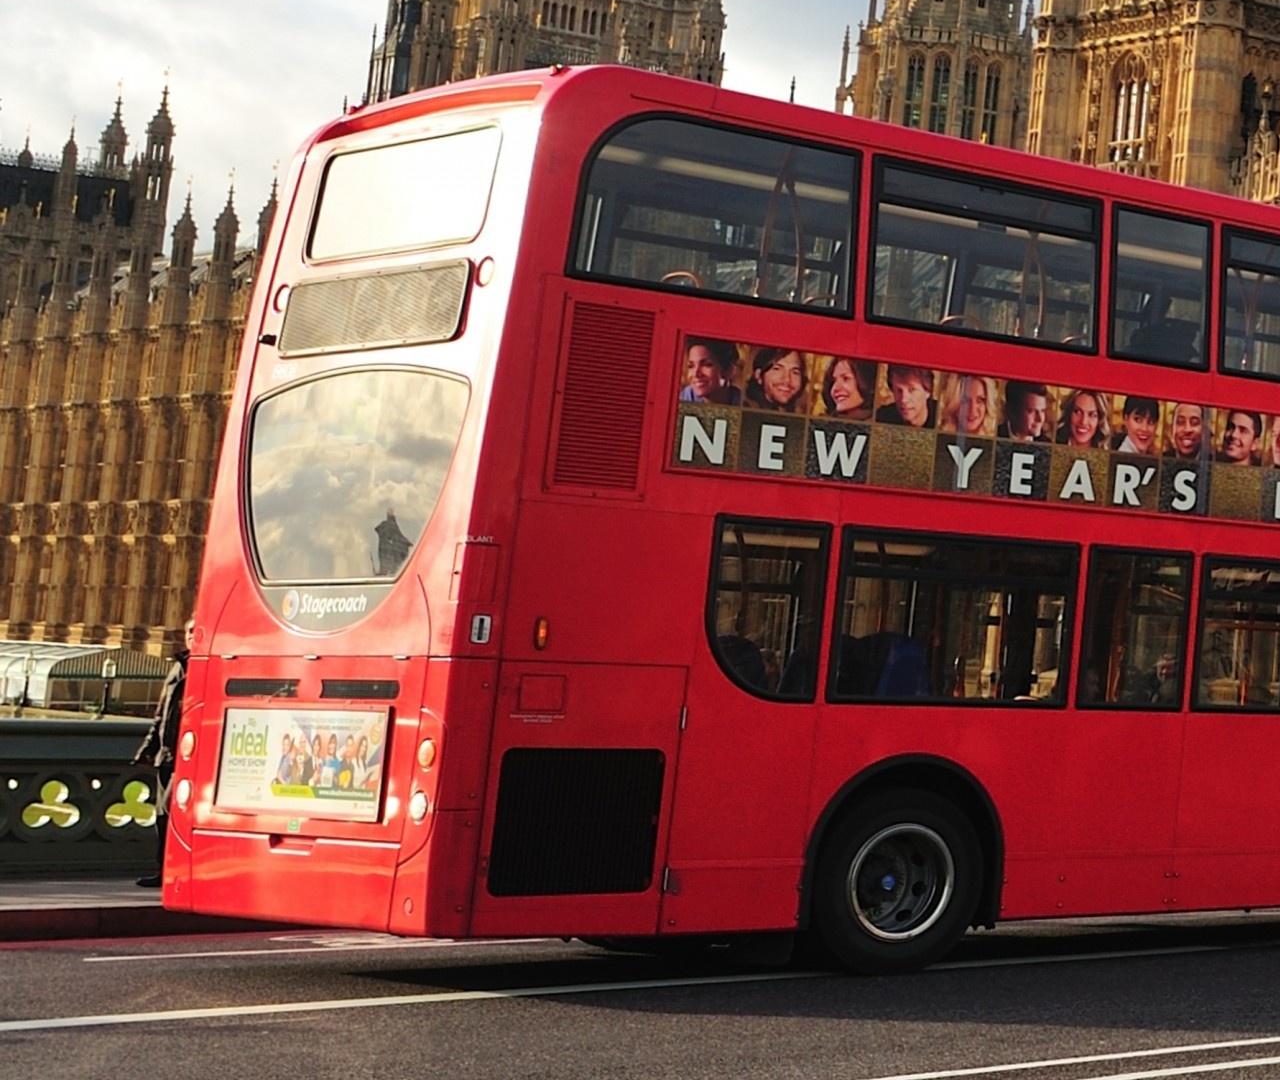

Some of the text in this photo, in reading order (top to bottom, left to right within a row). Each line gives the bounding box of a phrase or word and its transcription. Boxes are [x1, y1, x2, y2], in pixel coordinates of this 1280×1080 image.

[679, 416, 867, 477] NEW
[947, 445, 1197, 511] YEAR'S
[300, 593, 367, 618] Stagecoach
[230, 724, 269, 757] ideal
[228, 758, 267, 767] HOME SHOW
